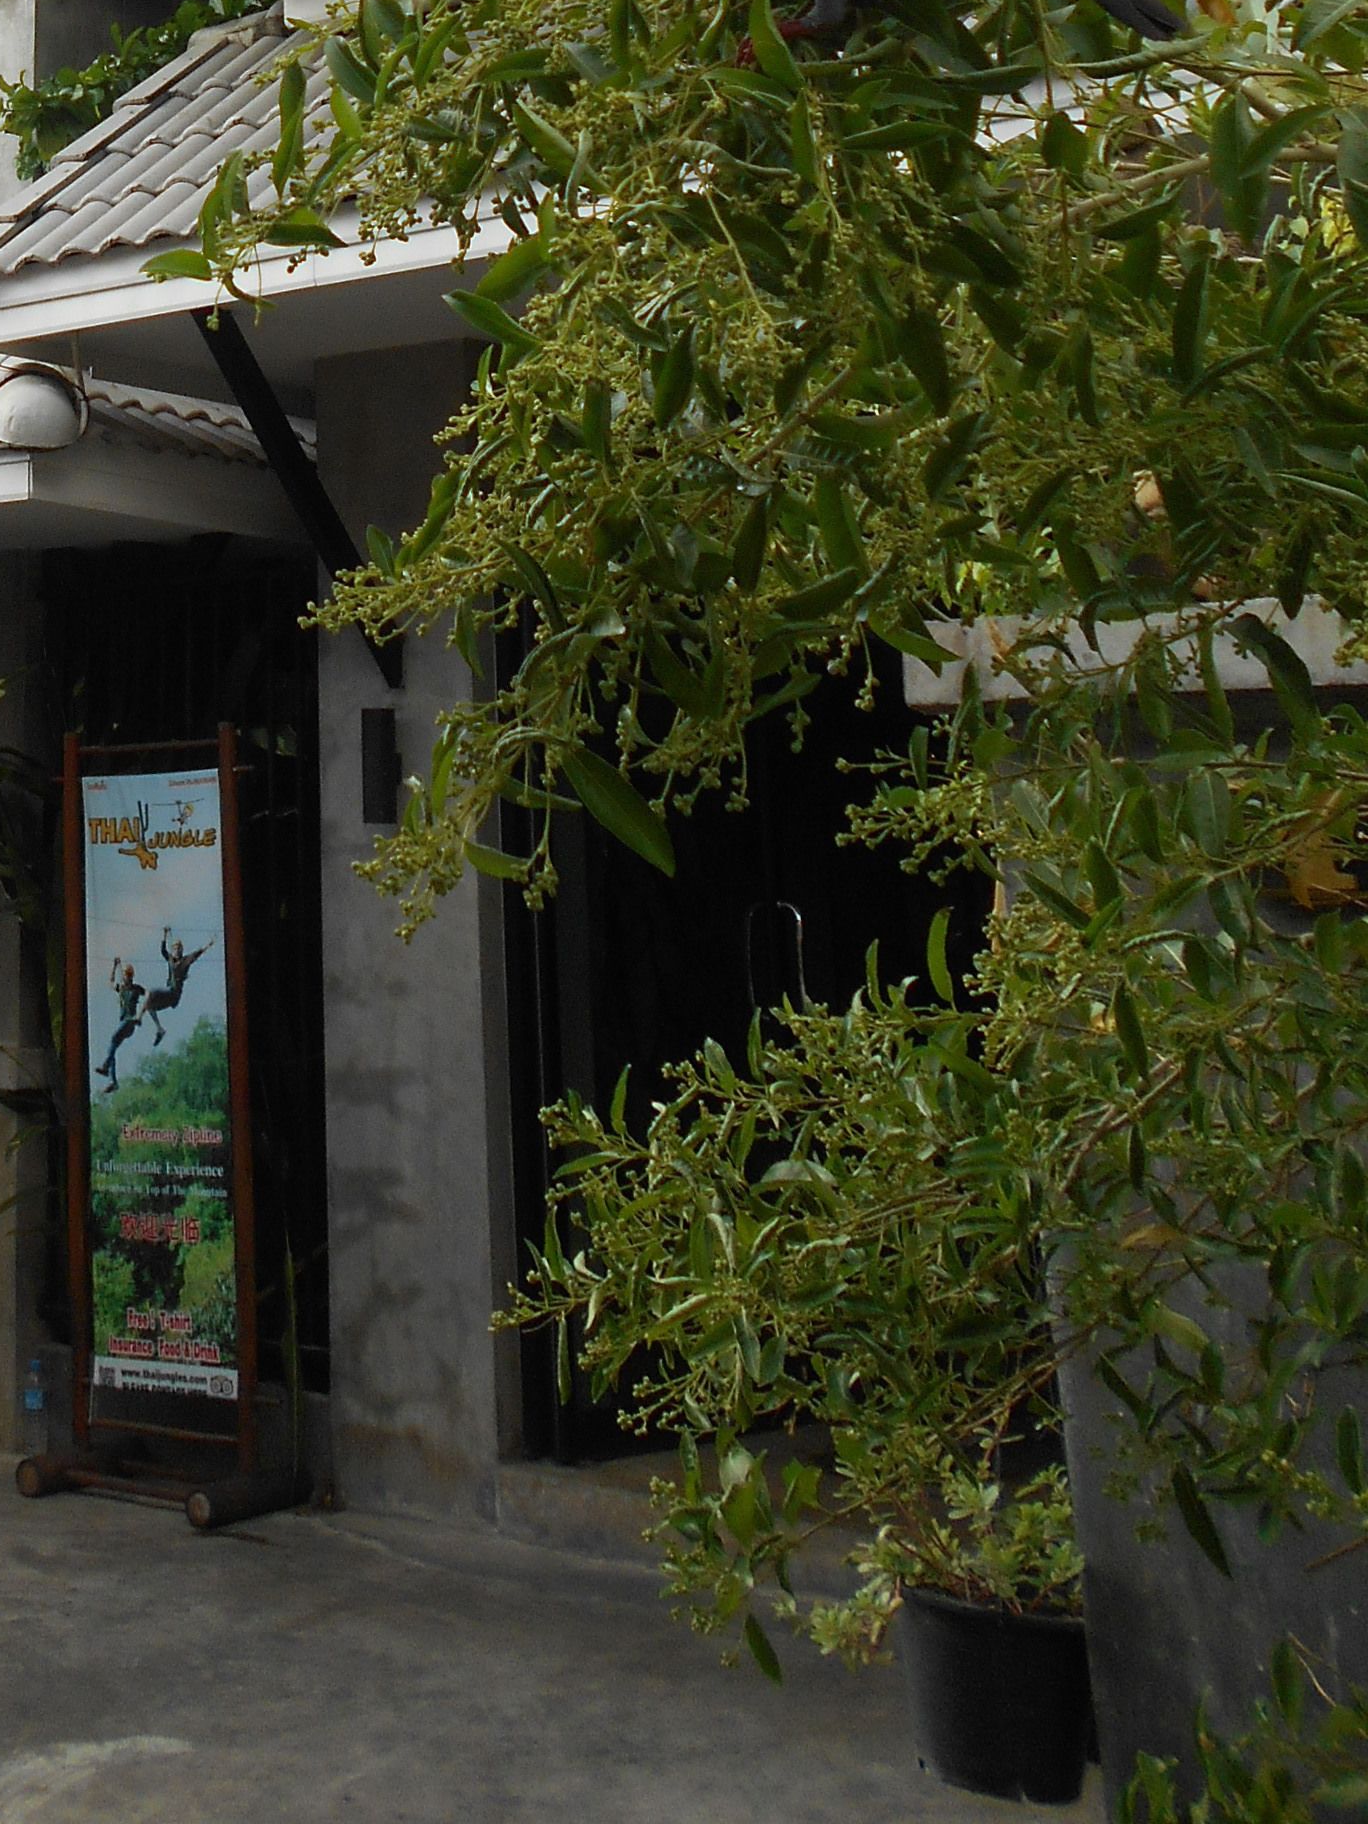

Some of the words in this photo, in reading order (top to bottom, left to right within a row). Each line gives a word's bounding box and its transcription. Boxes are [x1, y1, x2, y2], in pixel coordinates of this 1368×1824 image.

[88, 817, 141, 844] THAI
[148, 827, 218, 849] JUNGLE
[166, 1162, 224, 1180] Experience
